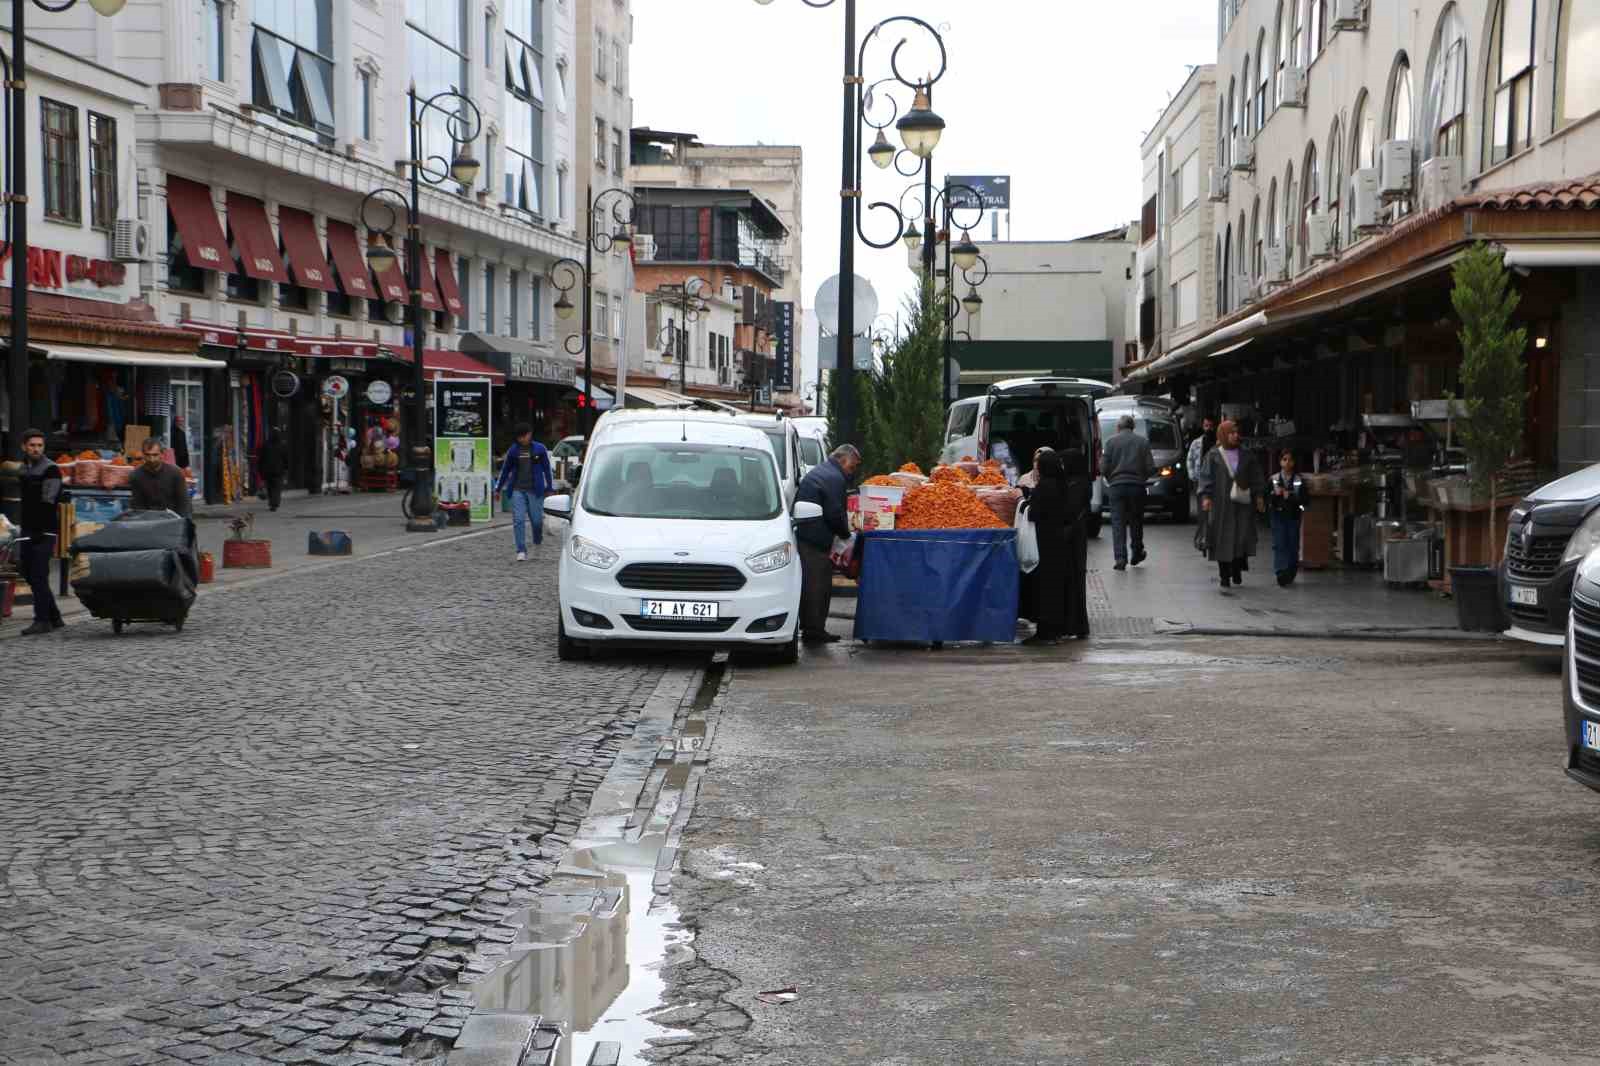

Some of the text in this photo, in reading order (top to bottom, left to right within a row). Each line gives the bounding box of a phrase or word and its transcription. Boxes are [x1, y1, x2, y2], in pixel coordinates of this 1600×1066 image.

[650, 602, 712, 616] 21 AY 621
